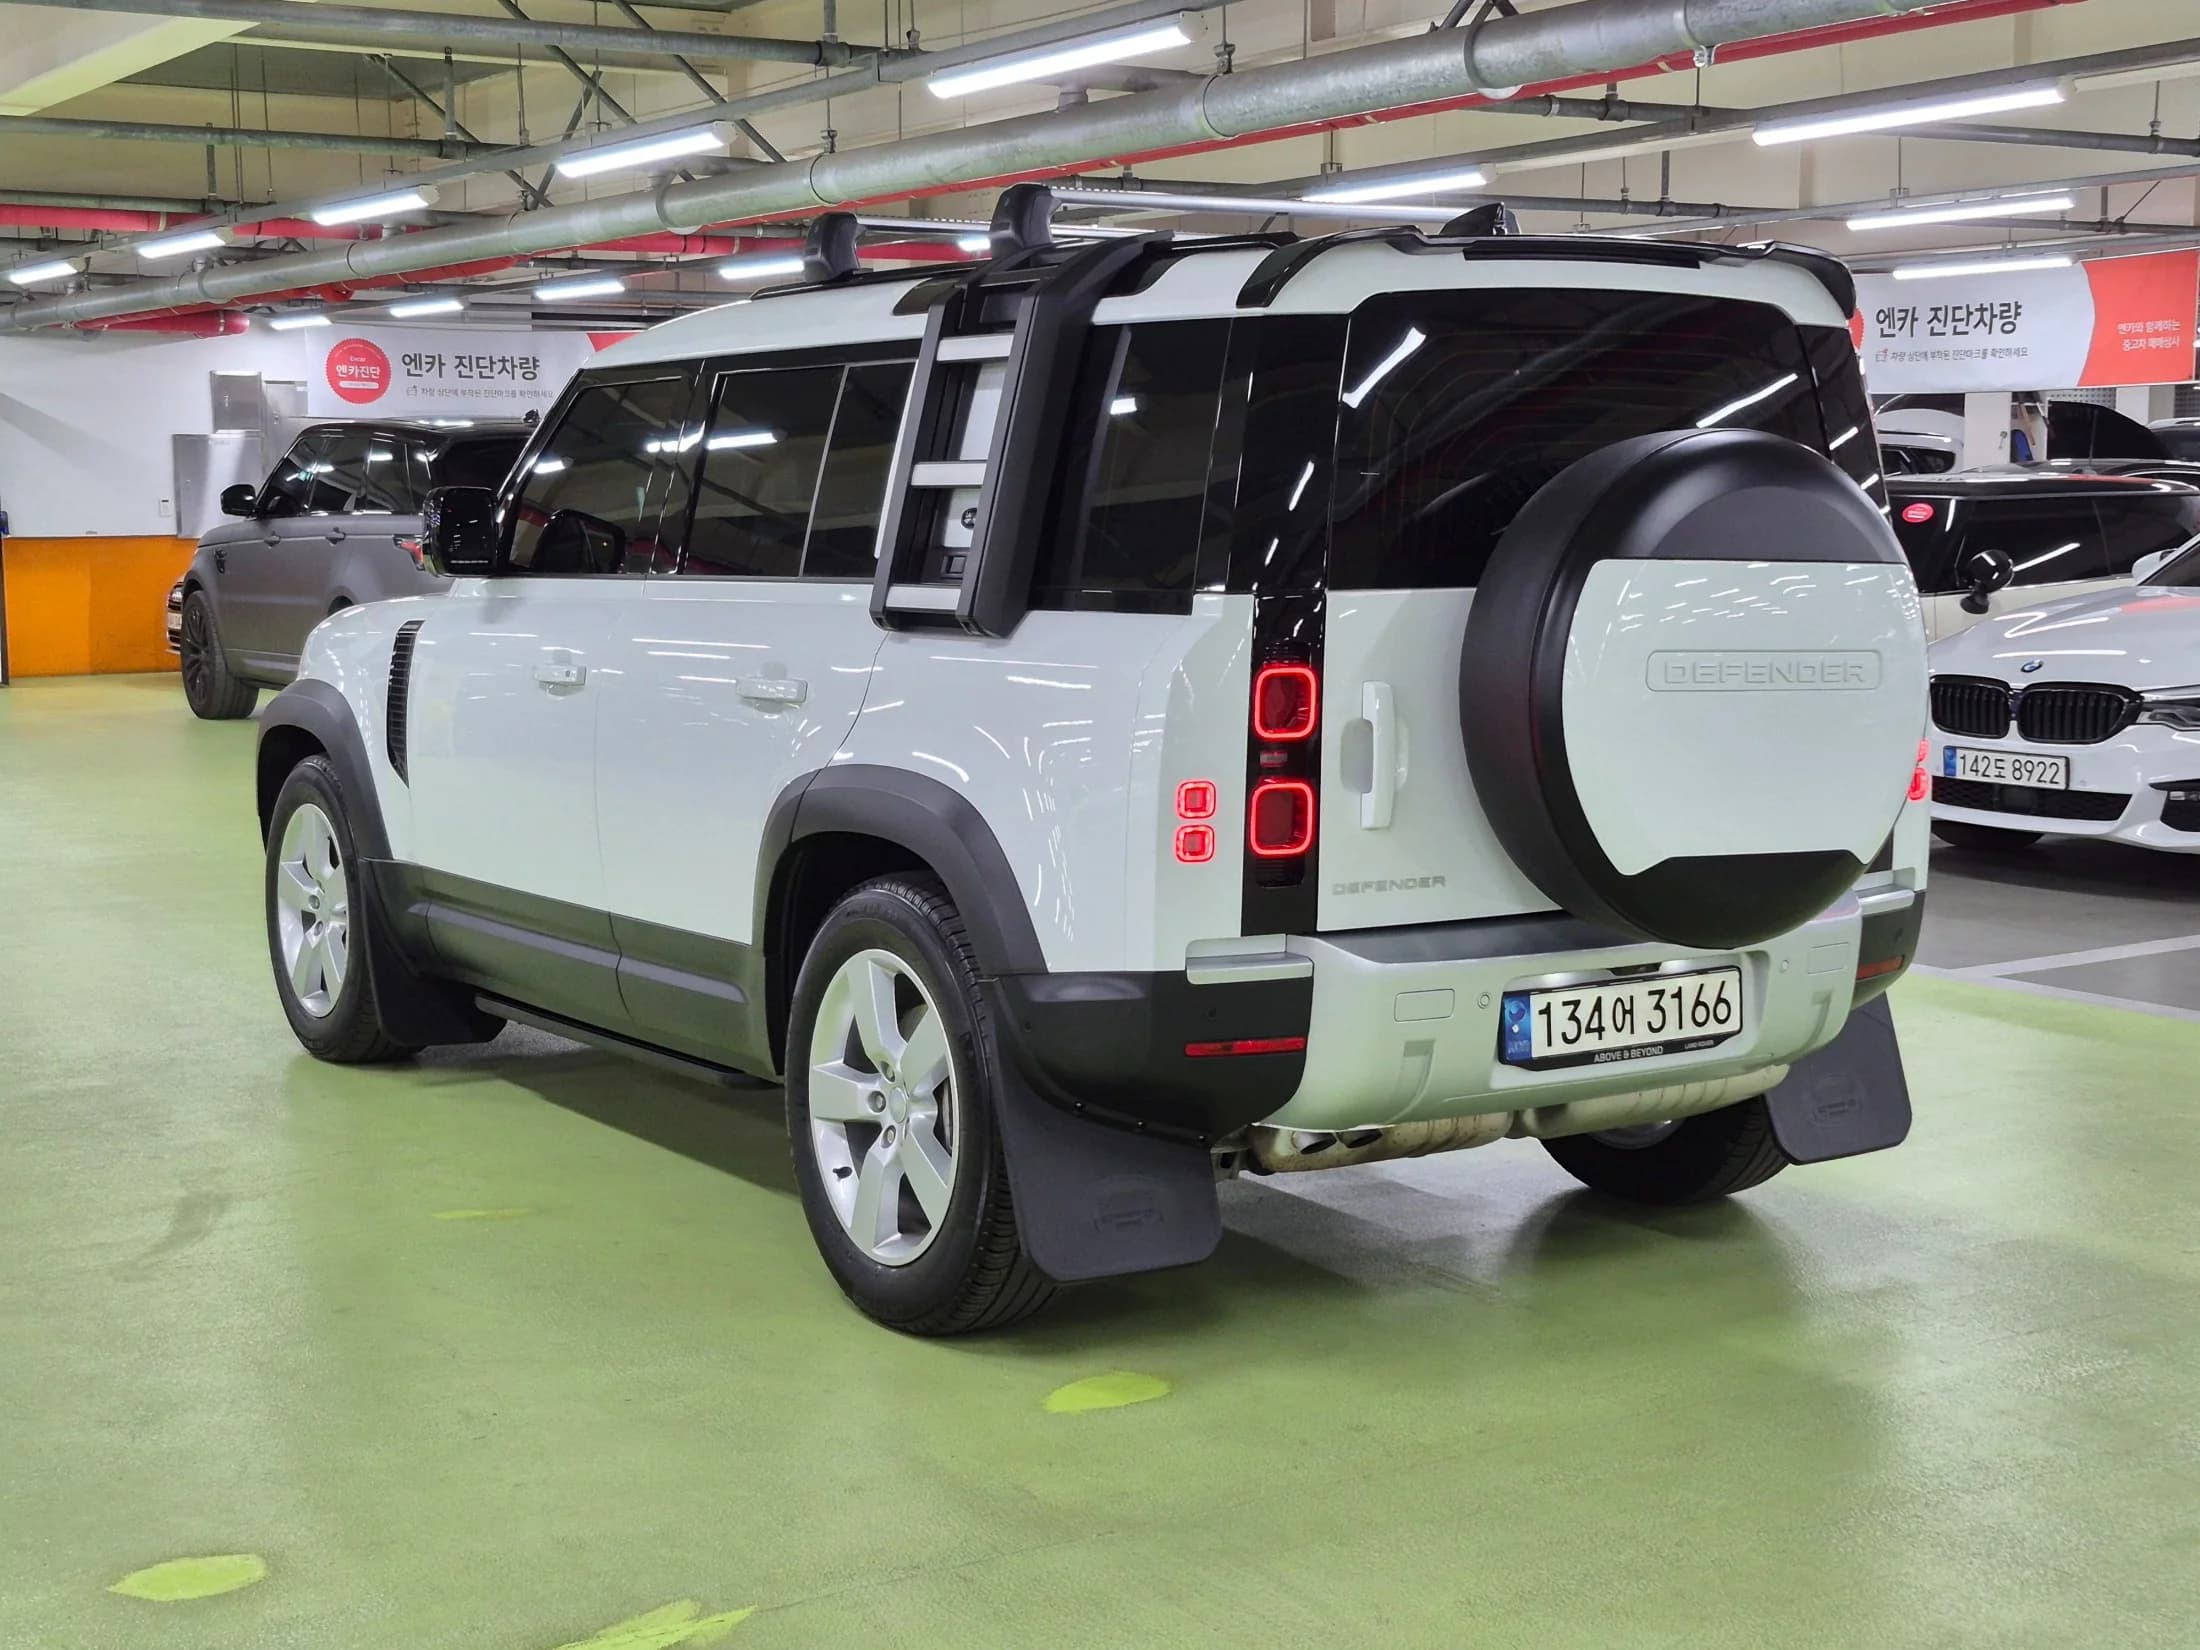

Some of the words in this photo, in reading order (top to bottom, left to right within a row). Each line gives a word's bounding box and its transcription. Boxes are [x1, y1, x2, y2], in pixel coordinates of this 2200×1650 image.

[1876, 307, 1918, 339] 엔카
[1927, 301, 2022, 336] 진단차량
[336, 364, 380, 379] 엔카진단
[401, 354, 446, 377] 엔카
[454, 353, 540, 381] 진단차량
[1664, 660, 1866, 683] DEFENDER
[1959, 753, 2006, 778] 142도
[2012, 758, 2060, 785] 8922
[1332, 876, 1446, 896] DEFENDER
[1538, 995, 1635, 1048] 134어
[1647, 980, 1732, 1034] 3166
[1593, 1052, 1622, 1064] ABOVE
[1630, 1046, 1664, 1059] BEYOND
